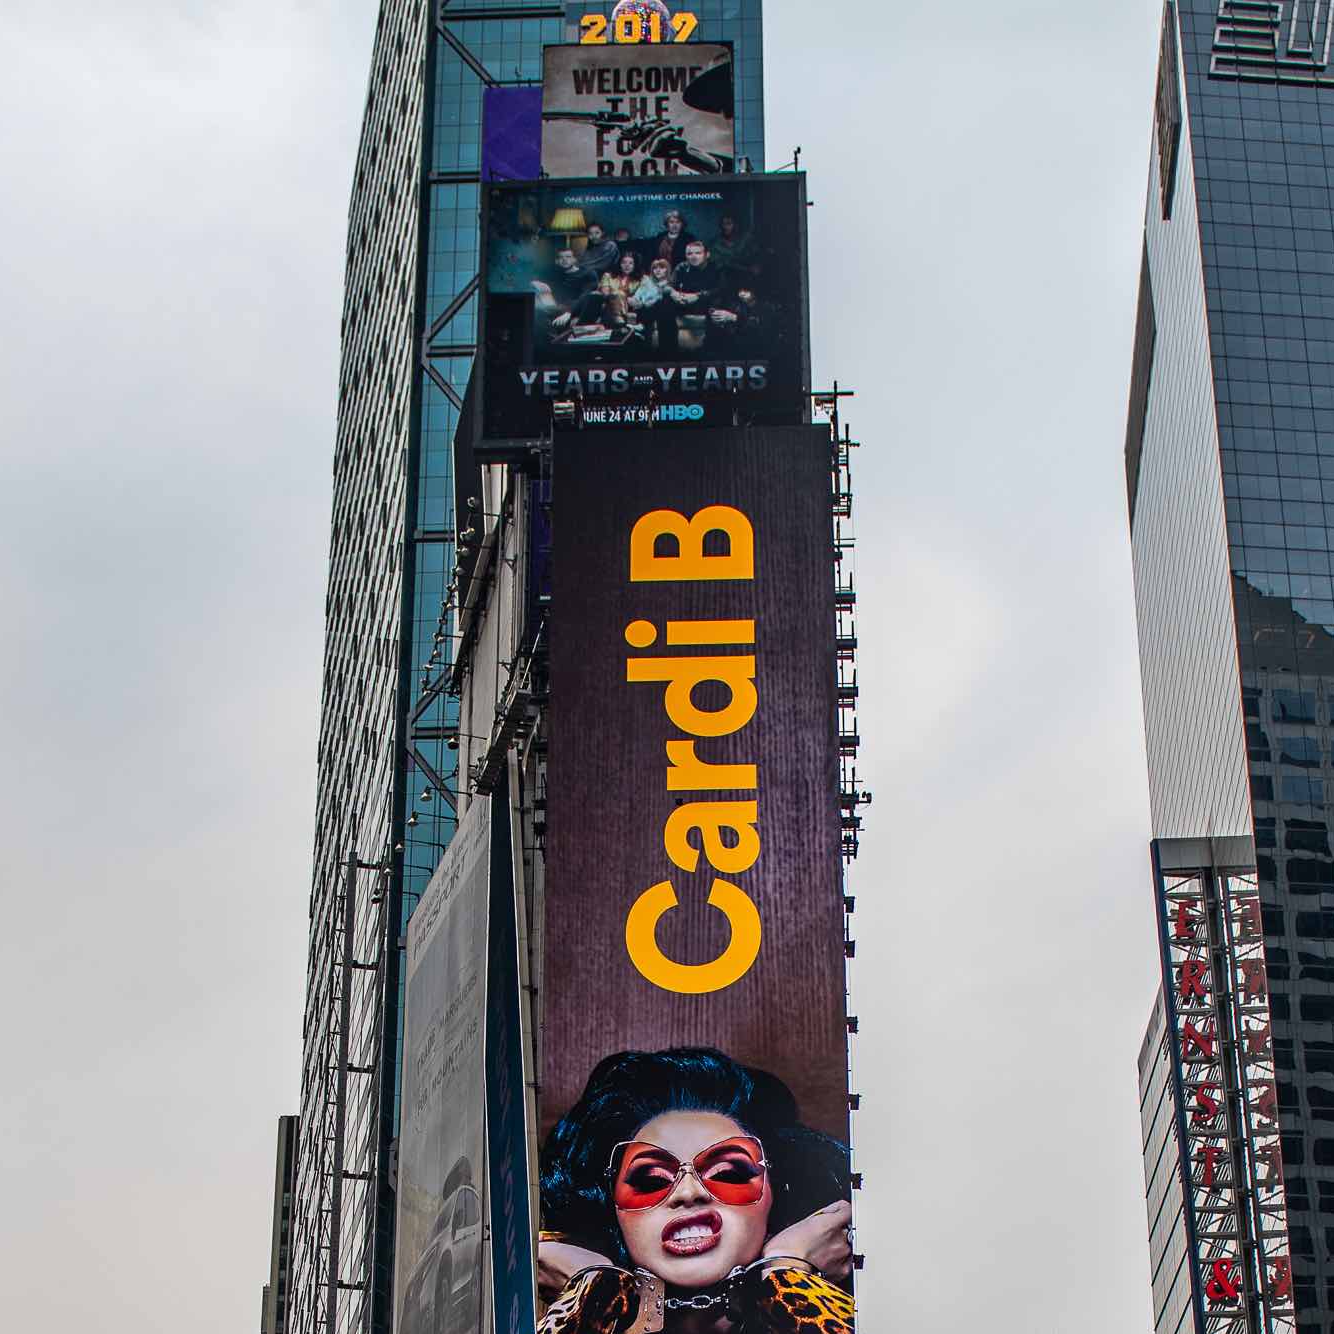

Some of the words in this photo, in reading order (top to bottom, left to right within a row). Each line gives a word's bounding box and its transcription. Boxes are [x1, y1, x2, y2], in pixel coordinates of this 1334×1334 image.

[580, 12, 698, 44] 2019
[626, 193, 664, 202] LIFETIME
[666, 193, 676, 201] OF
[519, 368, 629, 395] YEARS
[634, 375, 654, 384] AND
[656, 365, 768, 391] YEARS
[609, 410, 621, 422] 24
[624, 410, 637, 422] AT
[660, 404, 705, 421] HBO
[630, 505, 755, 582] B
[625, 620, 762, 994] Cardi
[1173, 898, 1224, 1188] ERNST
[1205, 1256, 1245, 1304] &
